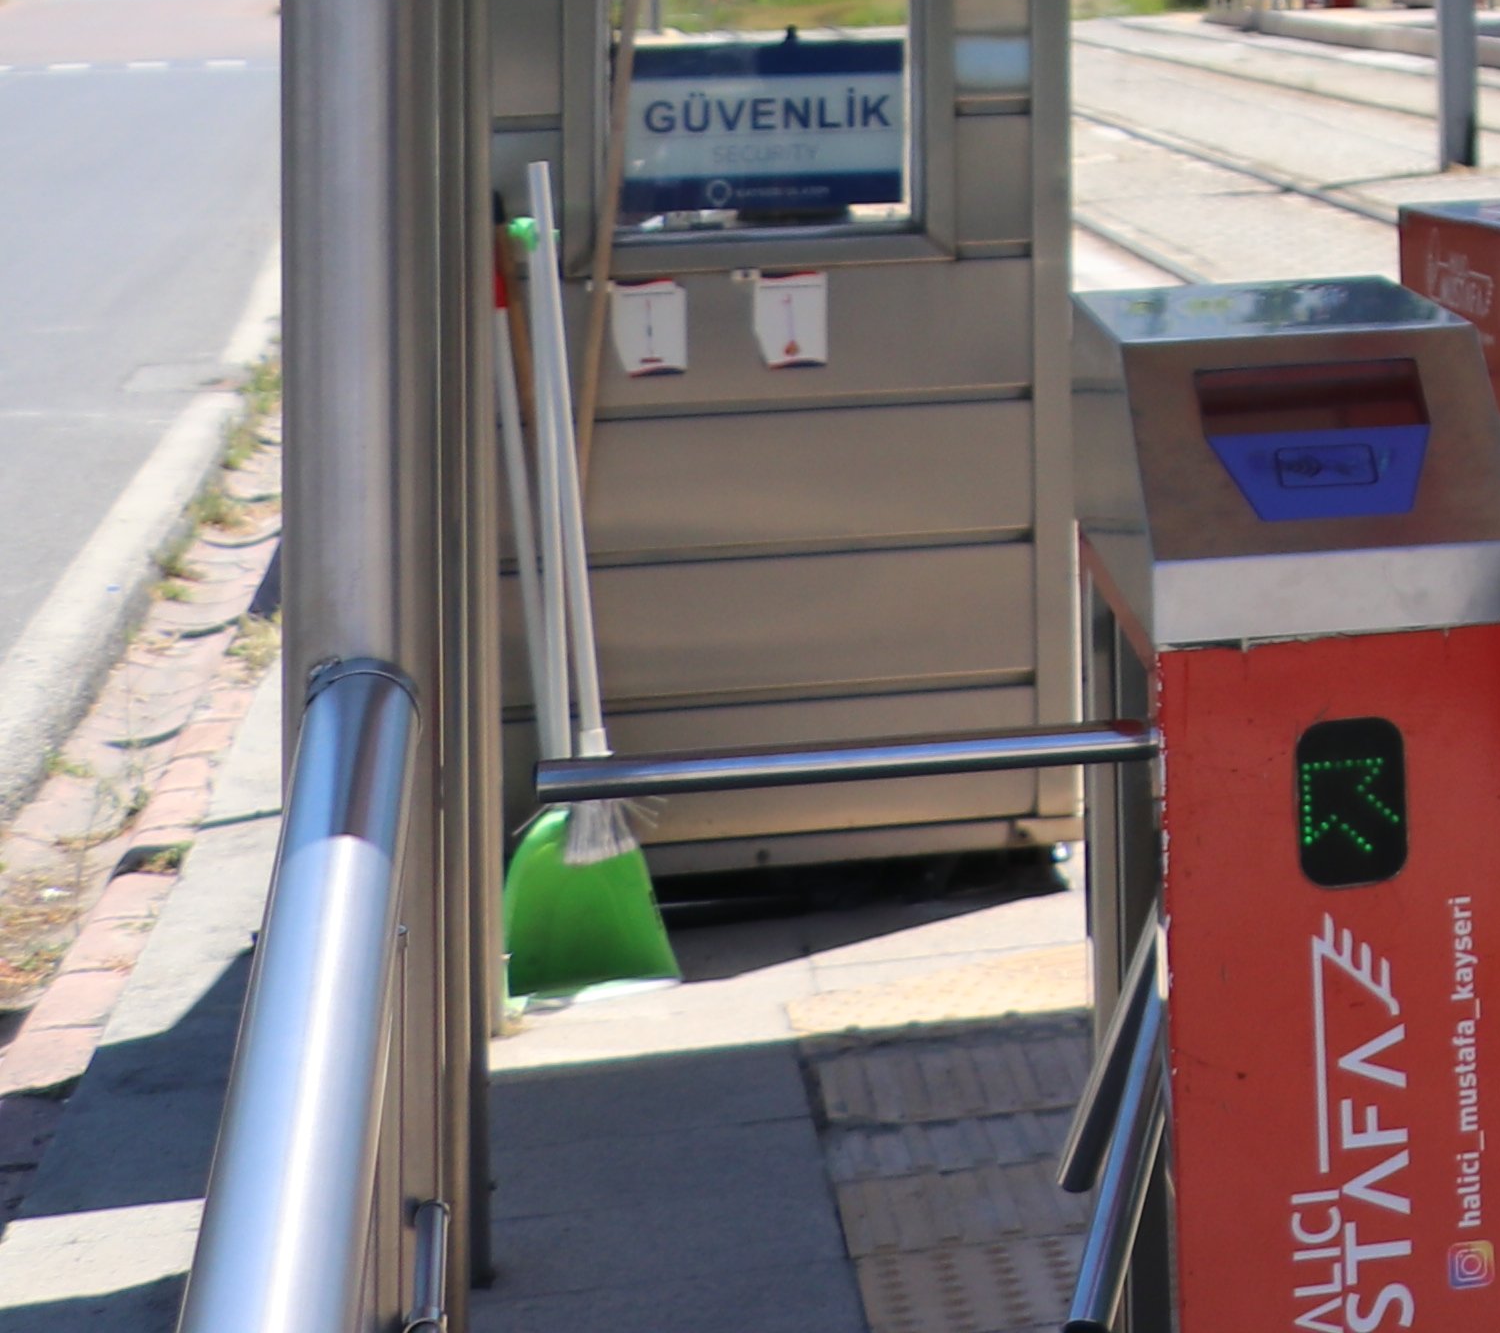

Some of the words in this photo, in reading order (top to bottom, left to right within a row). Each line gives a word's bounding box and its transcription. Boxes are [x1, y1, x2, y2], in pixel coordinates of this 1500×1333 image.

[643, 88, 891, 135] GÜVENLİK
[712, 142, 819, 167] SECURITY
[1447, 894, 1485, 1230] halici_mustafa_kayseri
[1338, 1023, 1415, 1333] STAFA
[1290, 1189, 1344, 1333] ALICI
